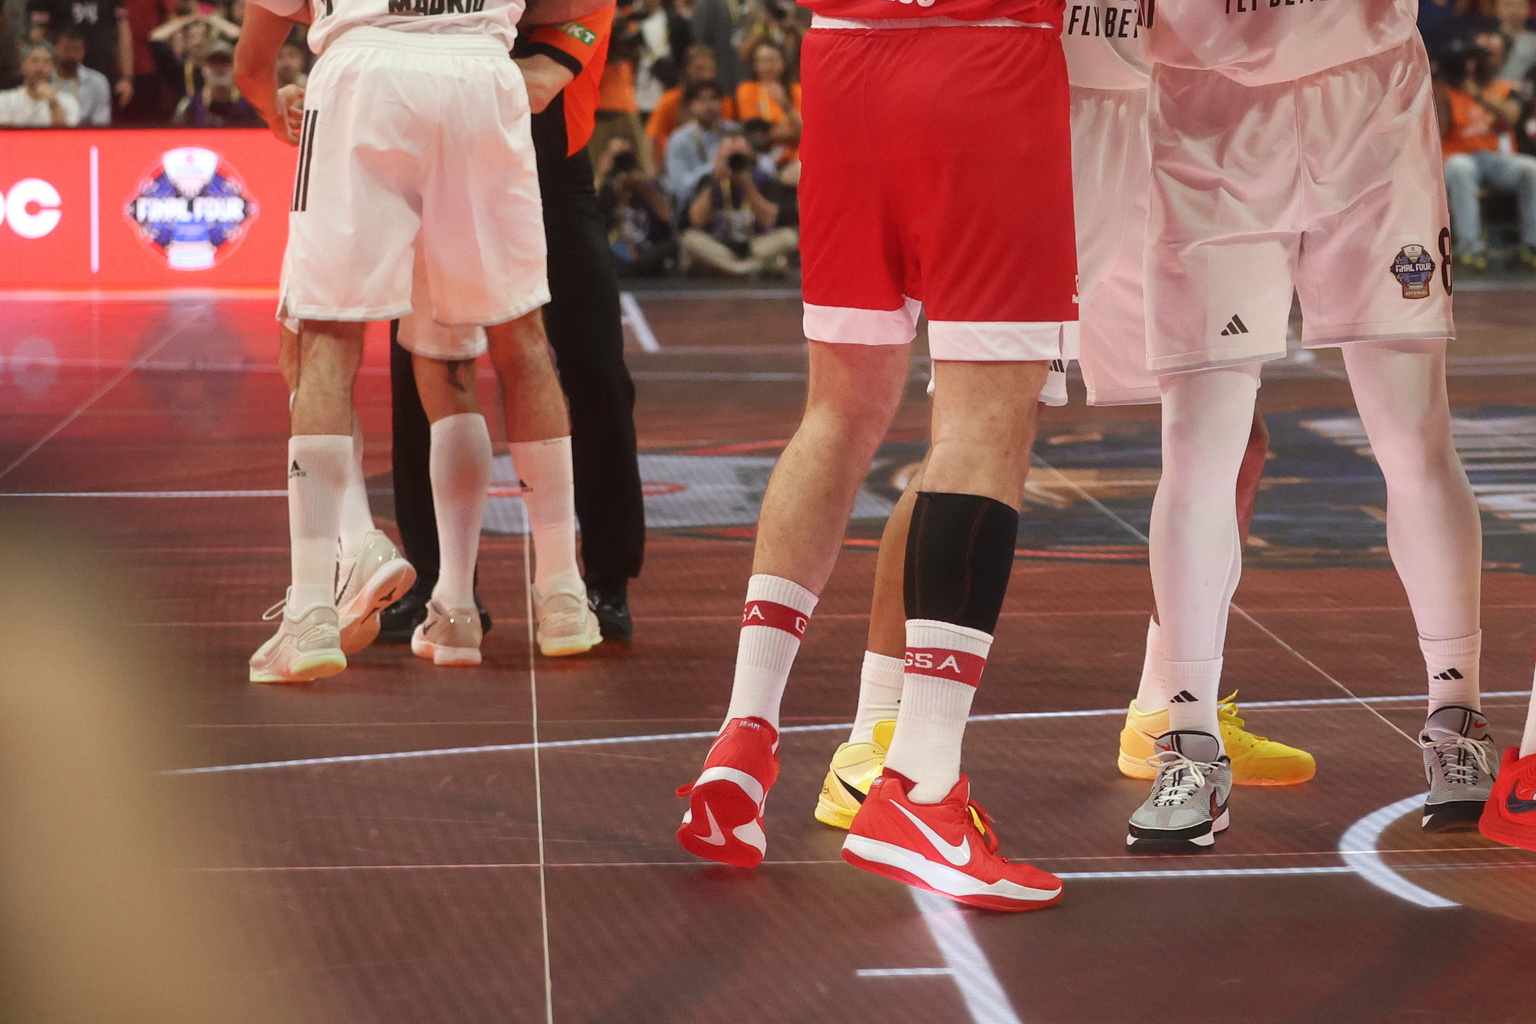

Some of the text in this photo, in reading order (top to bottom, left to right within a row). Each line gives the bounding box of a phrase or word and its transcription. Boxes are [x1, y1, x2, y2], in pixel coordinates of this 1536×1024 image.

[1068, 5, 1100, 36] FLY
[1395, 262, 1432, 273] FINAL FOUR
[904, 651, 961, 674] GSA
